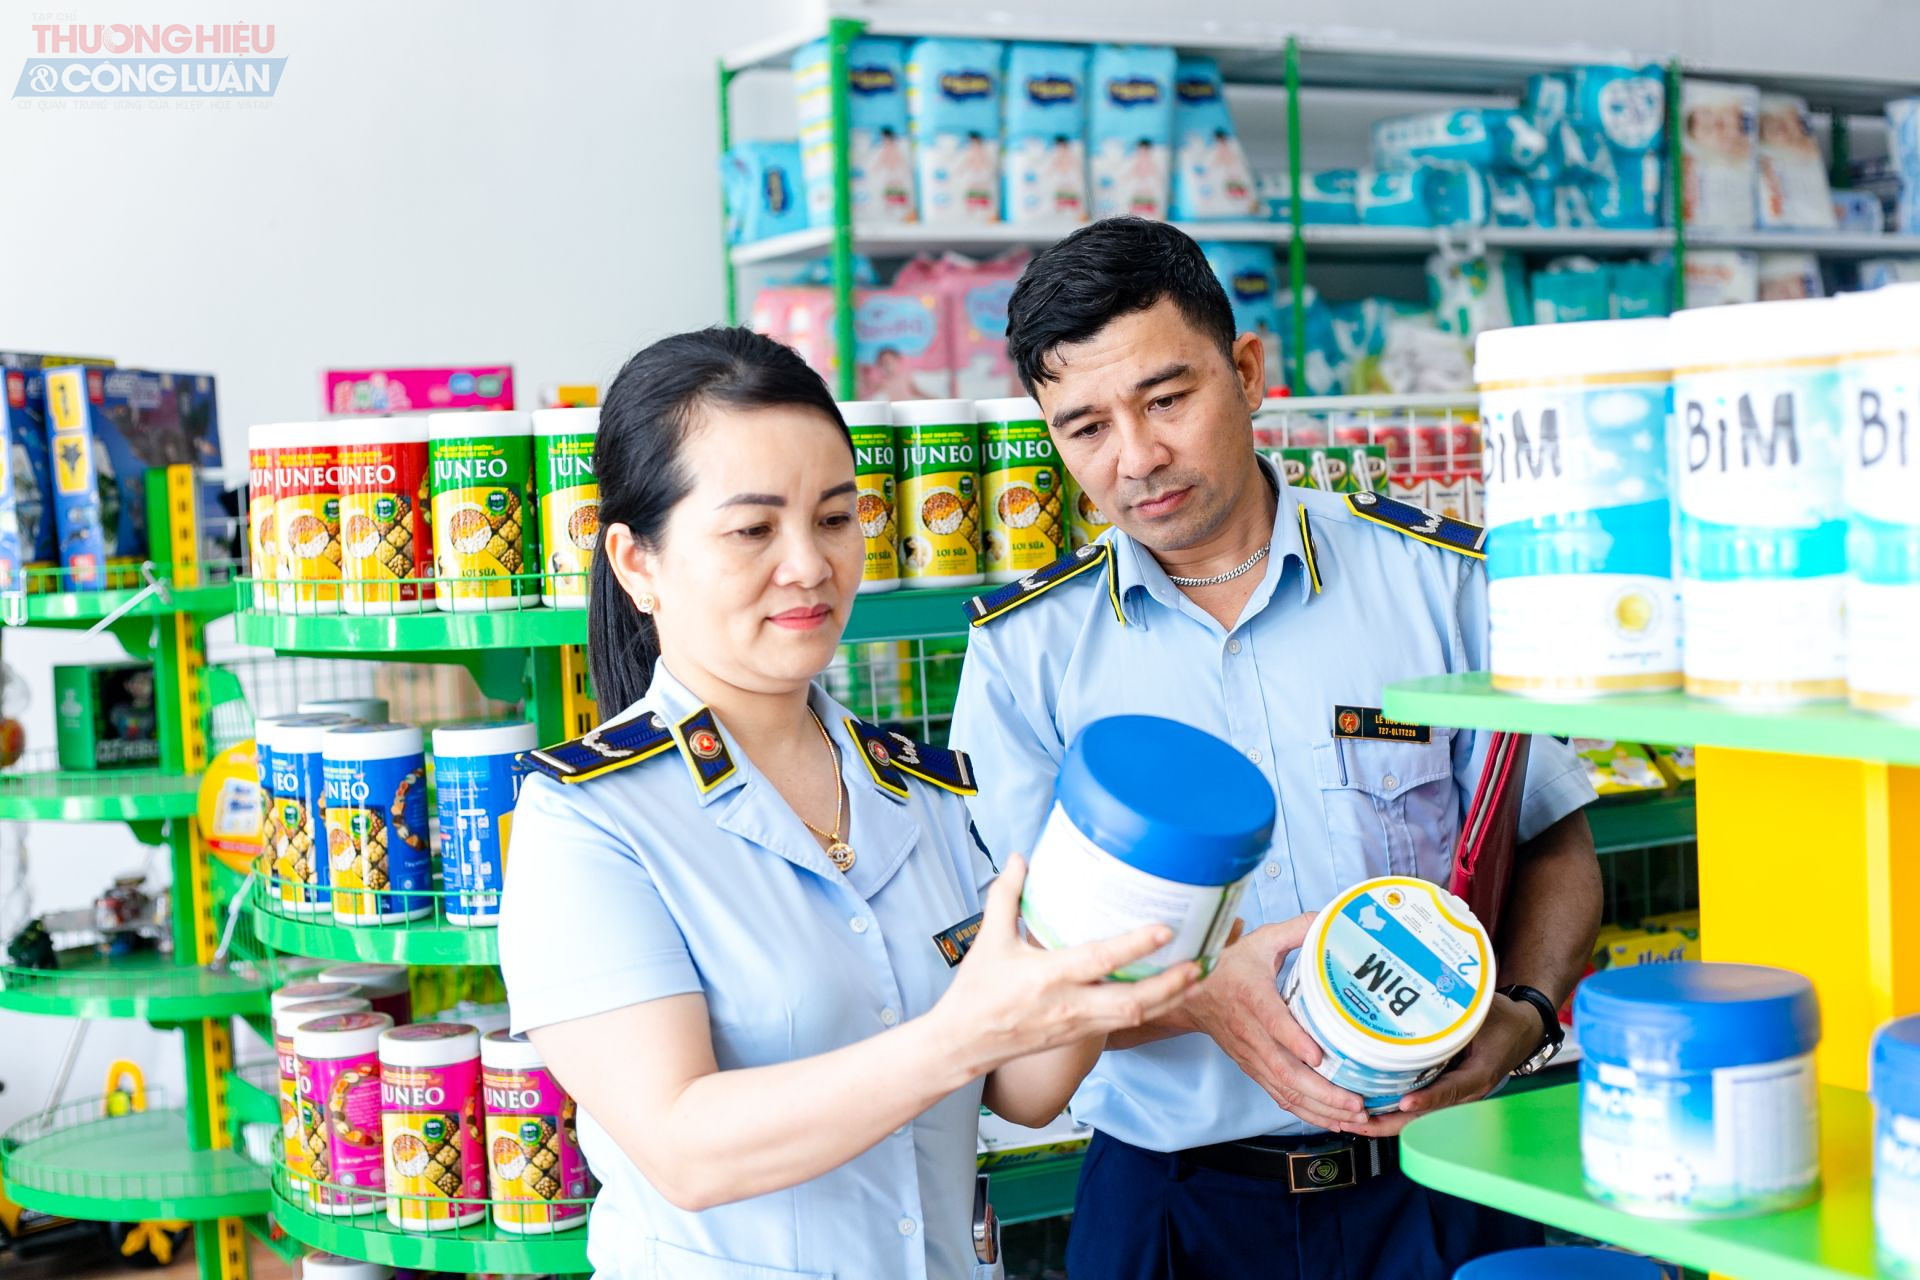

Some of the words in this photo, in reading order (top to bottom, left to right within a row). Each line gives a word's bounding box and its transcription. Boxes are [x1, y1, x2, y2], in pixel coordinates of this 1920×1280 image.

[1687, 392, 1800, 473] BiM
[856, 446, 894, 466] NEO
[903, 445, 973, 472] JUNEO
[981, 440, 1052, 466] JUNEO
[338, 465, 396, 486] UNEO
[434, 458, 508, 488] JUNEO
[550, 457, 594, 486] JUN
[325, 780, 370, 801] NEO
[1456, 953, 1480, 977] 2
[1354, 953, 1421, 1017] BiM
[485, 1089, 541, 1109] UNEO
